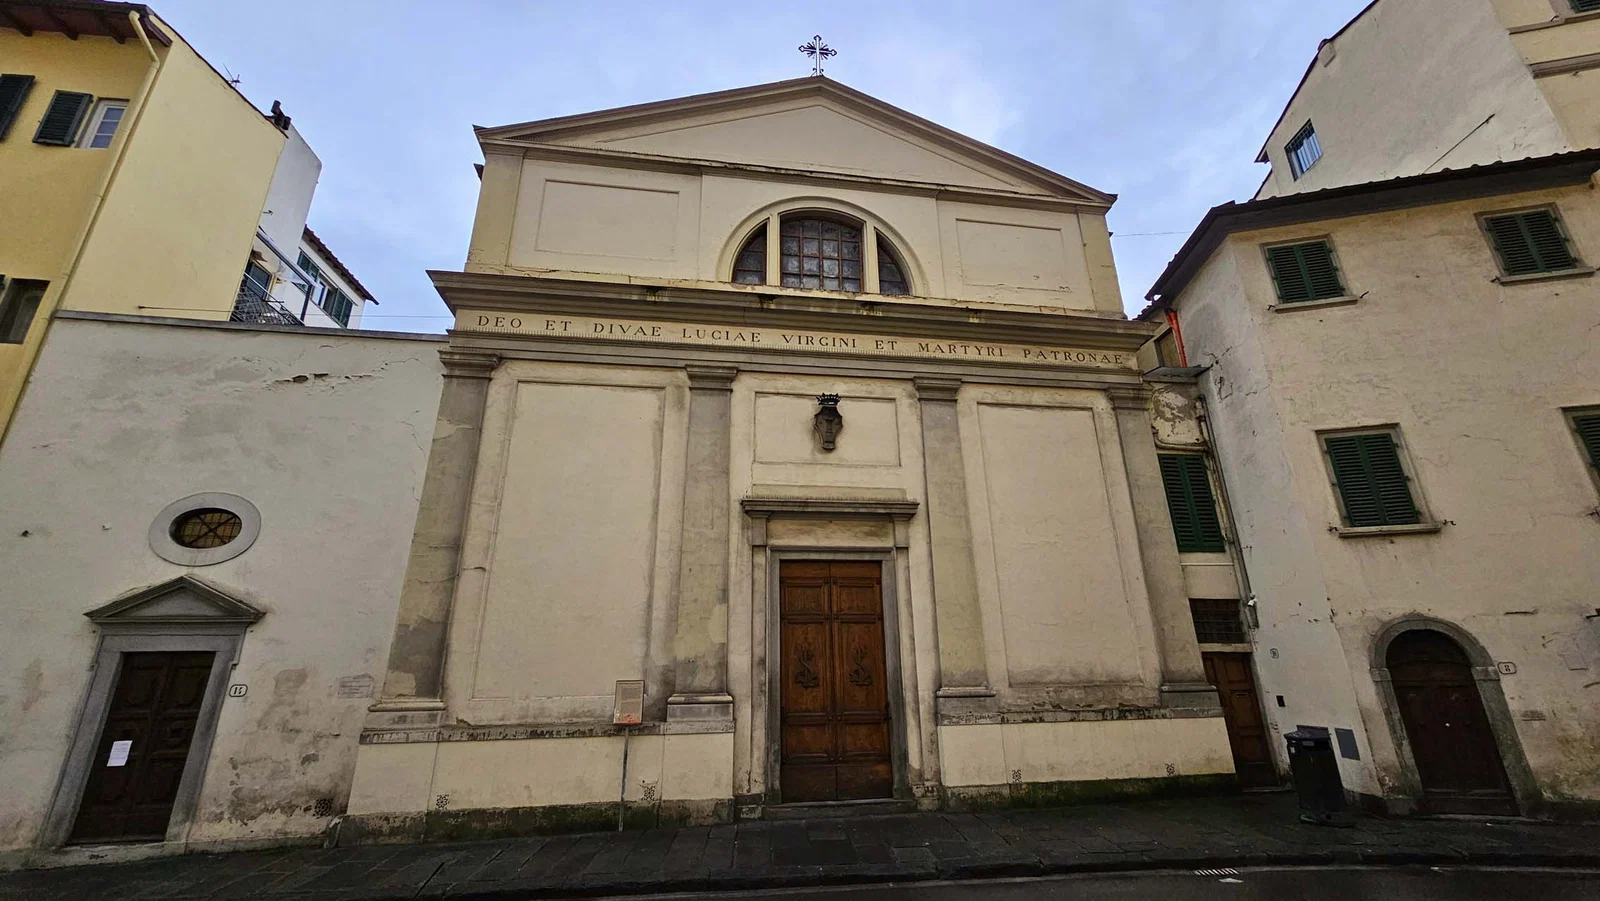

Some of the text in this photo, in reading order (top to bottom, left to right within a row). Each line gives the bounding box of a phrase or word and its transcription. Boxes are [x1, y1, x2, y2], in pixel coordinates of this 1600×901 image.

[477, 315, 1123, 365] DEO ET DIVAE LUCIAE VIRGINI ET MARTYRI PATRONAE
